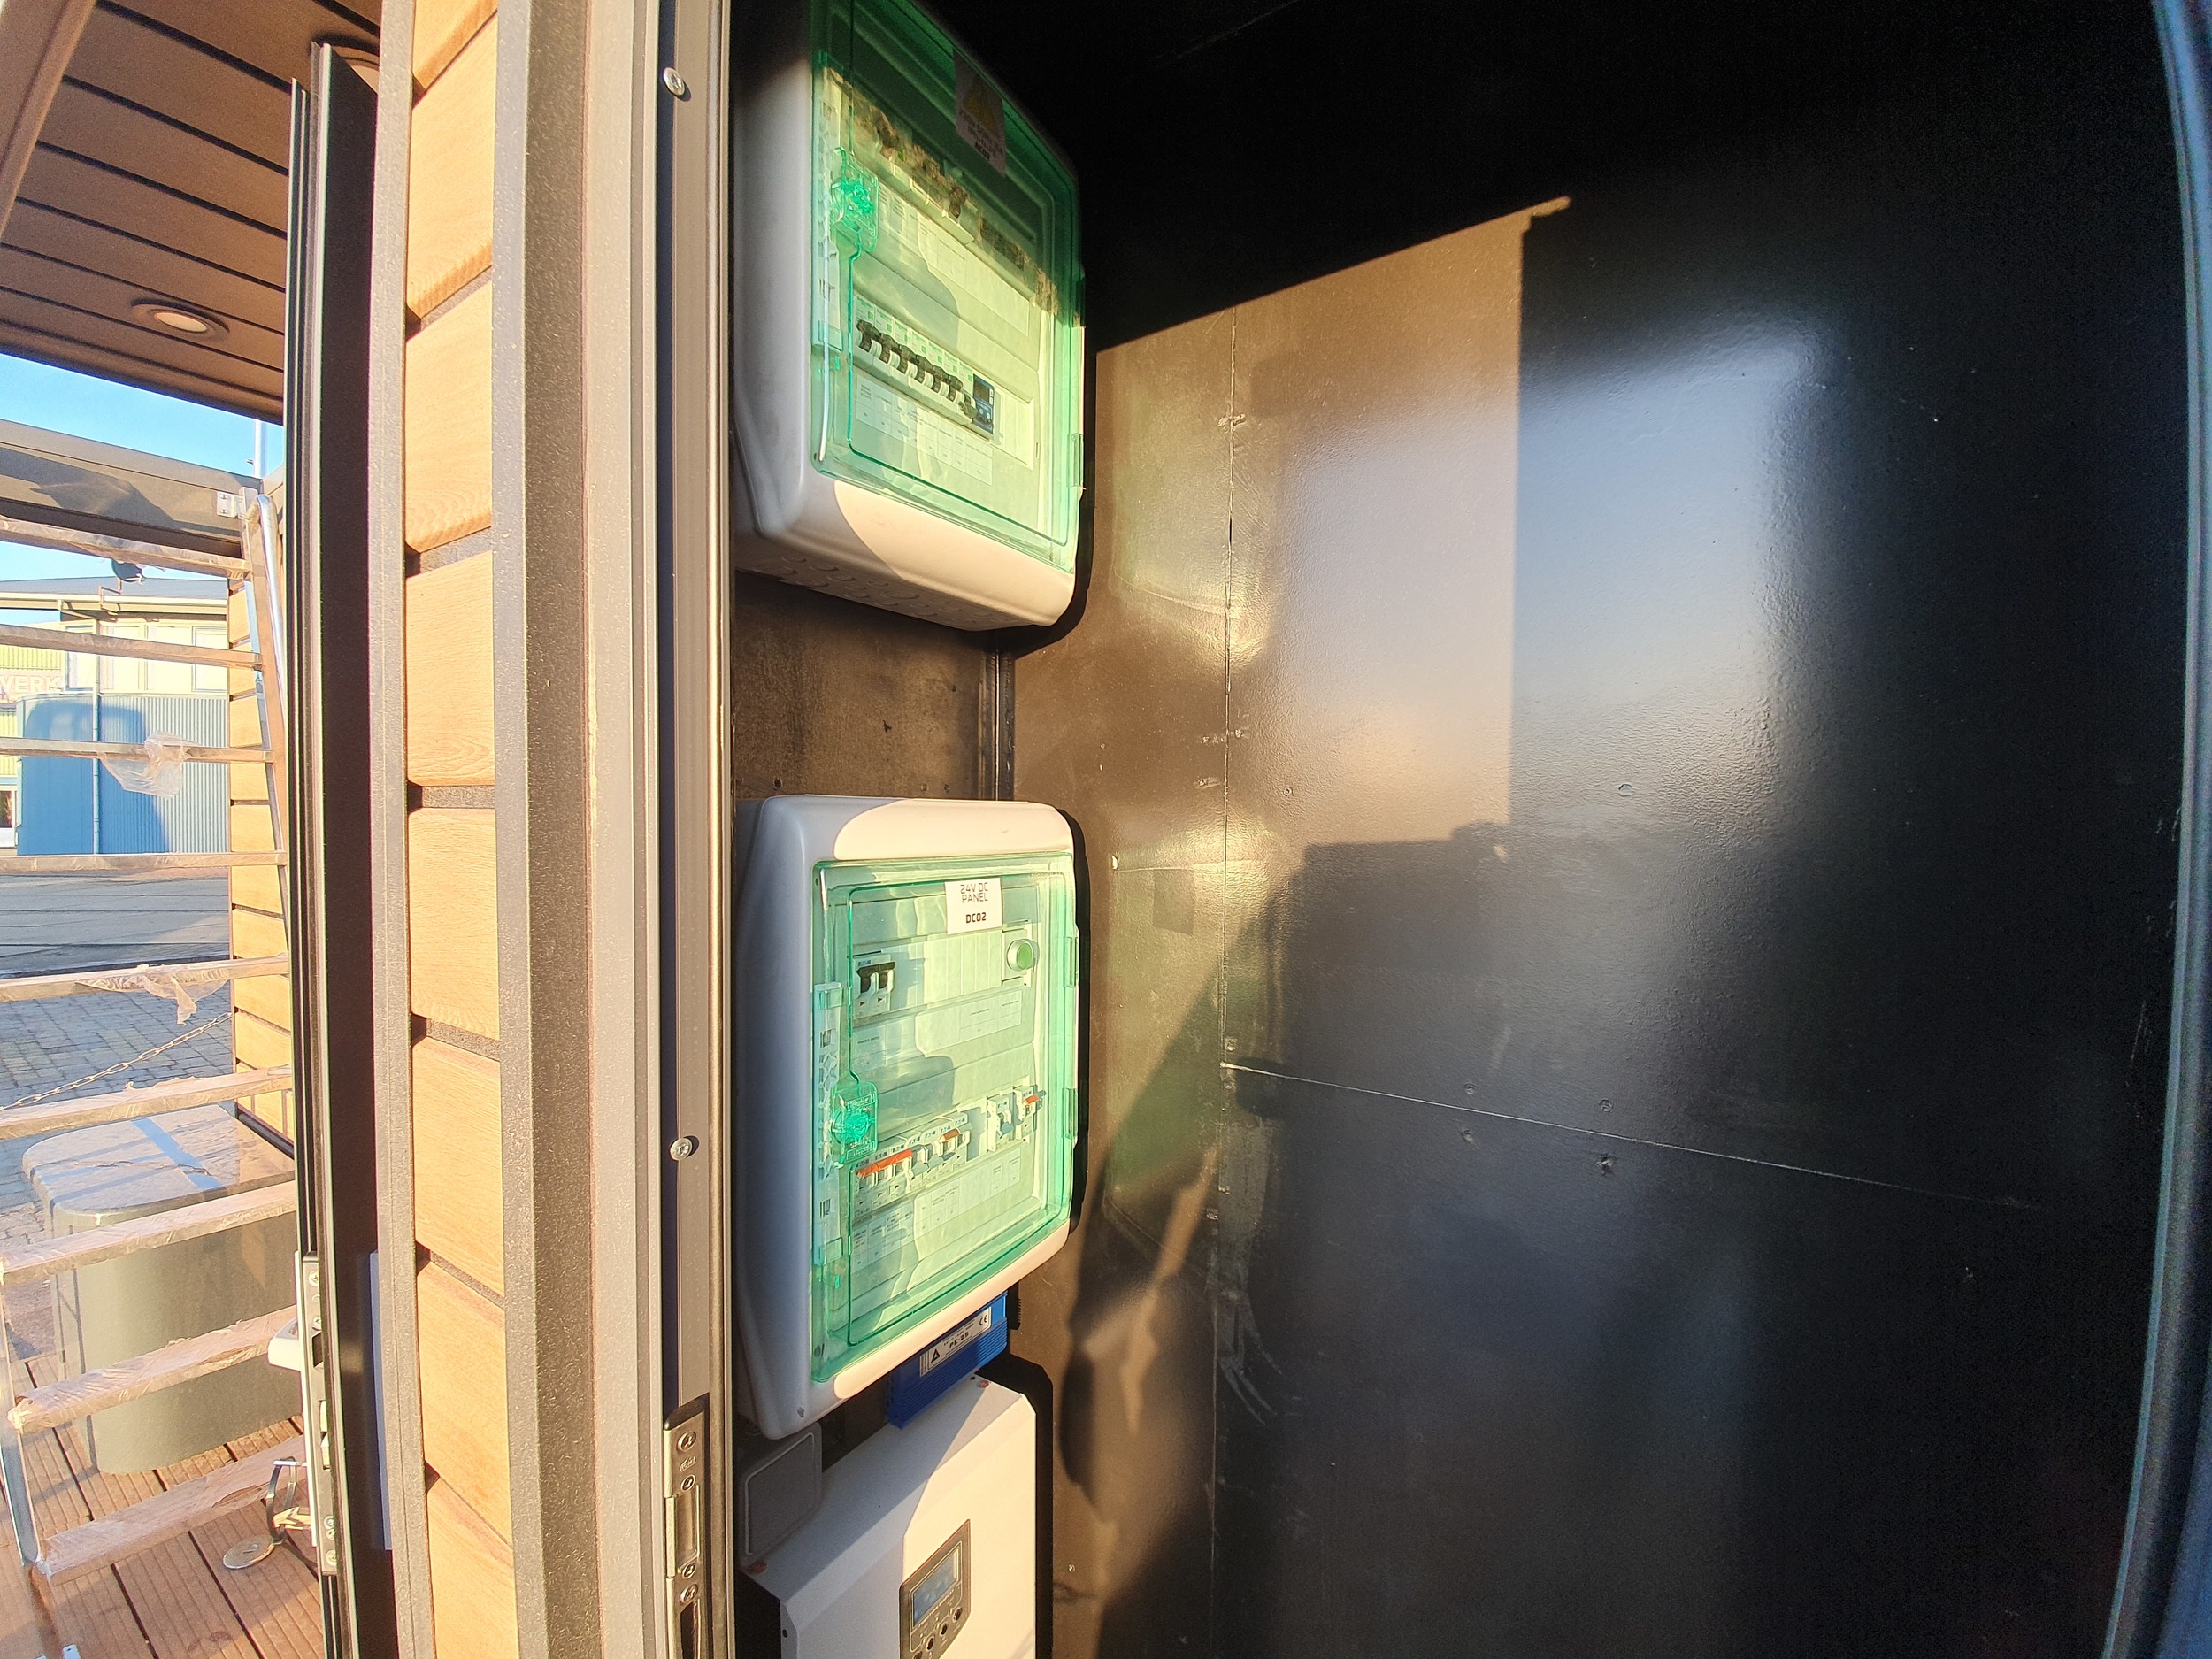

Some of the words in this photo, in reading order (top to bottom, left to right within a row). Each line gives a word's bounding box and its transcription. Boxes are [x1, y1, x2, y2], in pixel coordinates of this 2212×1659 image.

[960, 883, 976, 894] 24V
[978, 882, 988, 892] DC
[962, 892, 988, 903] PANEL
[965, 912, 987, 924] DC02
